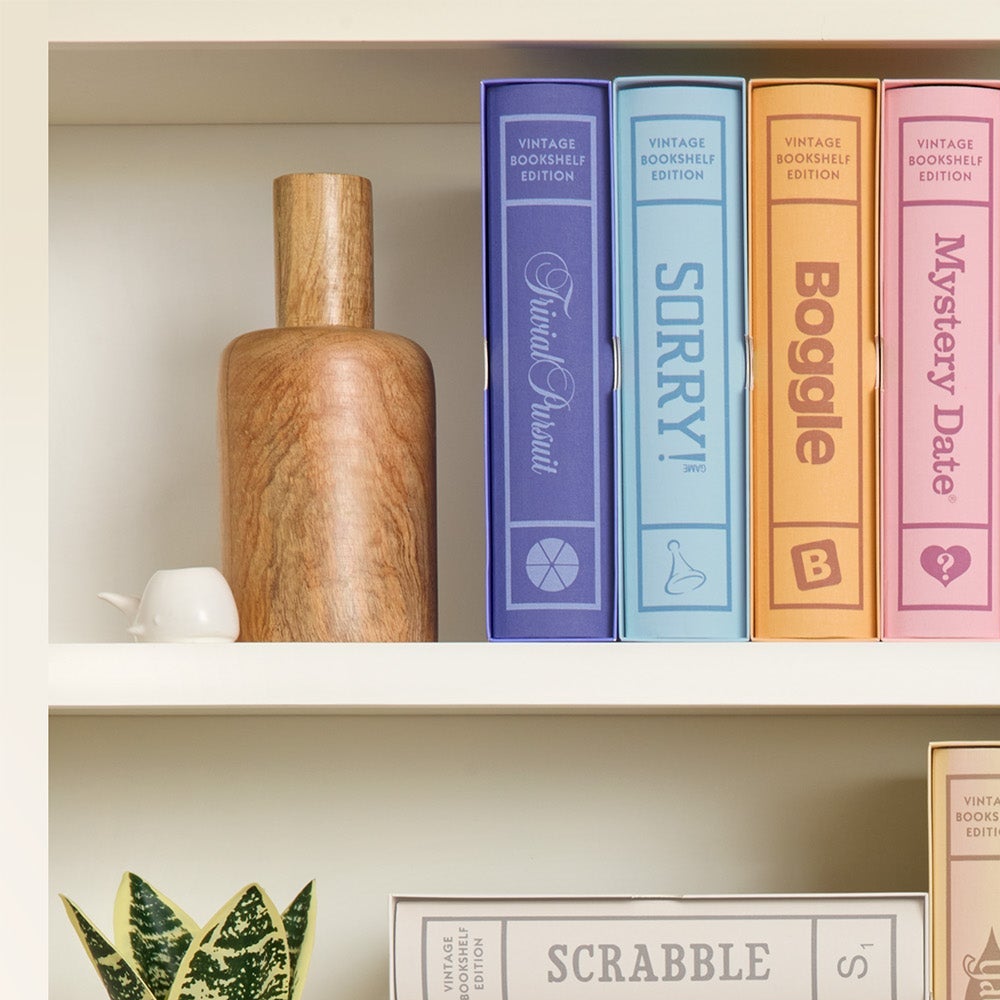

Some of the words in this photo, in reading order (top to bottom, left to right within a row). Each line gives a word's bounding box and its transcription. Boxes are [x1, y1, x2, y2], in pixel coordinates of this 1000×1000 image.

[518, 137, 576, 150] VINTAGE
[648, 137, 706, 149] VINTAGE
[784, 136, 842, 149] VINTAGE
[916, 138, 974, 150] VINTAGE
[510, 153, 586, 166] BOOKSHELF
[640, 153, 716, 166] BOOKSHELF
[776, 152, 851, 165] BOOKSHELF
[908, 154, 983, 167] BOOKSHELF
[520, 170, 575, 182] EDITION
[651, 169, 704, 181] EDITION
[787, 168, 840, 180] EDITION
[919, 170, 972, 182] EDITION
[524, 251, 574, 363] Trivial
[927, 234, 966, 396] Mystery
[655, 262, 706, 462] SORRY!
[788, 262, 843, 465] Boggle
[528, 360, 576, 475] Pursuit
[682, 463, 707, 473] GAME
[442, 936, 454, 993] VINTAGE
[458, 926, 470, 1000] BOOKSHELF
[473, 937, 485, 991] EDITION
[547, 942, 771, 983] SCRABBLE
